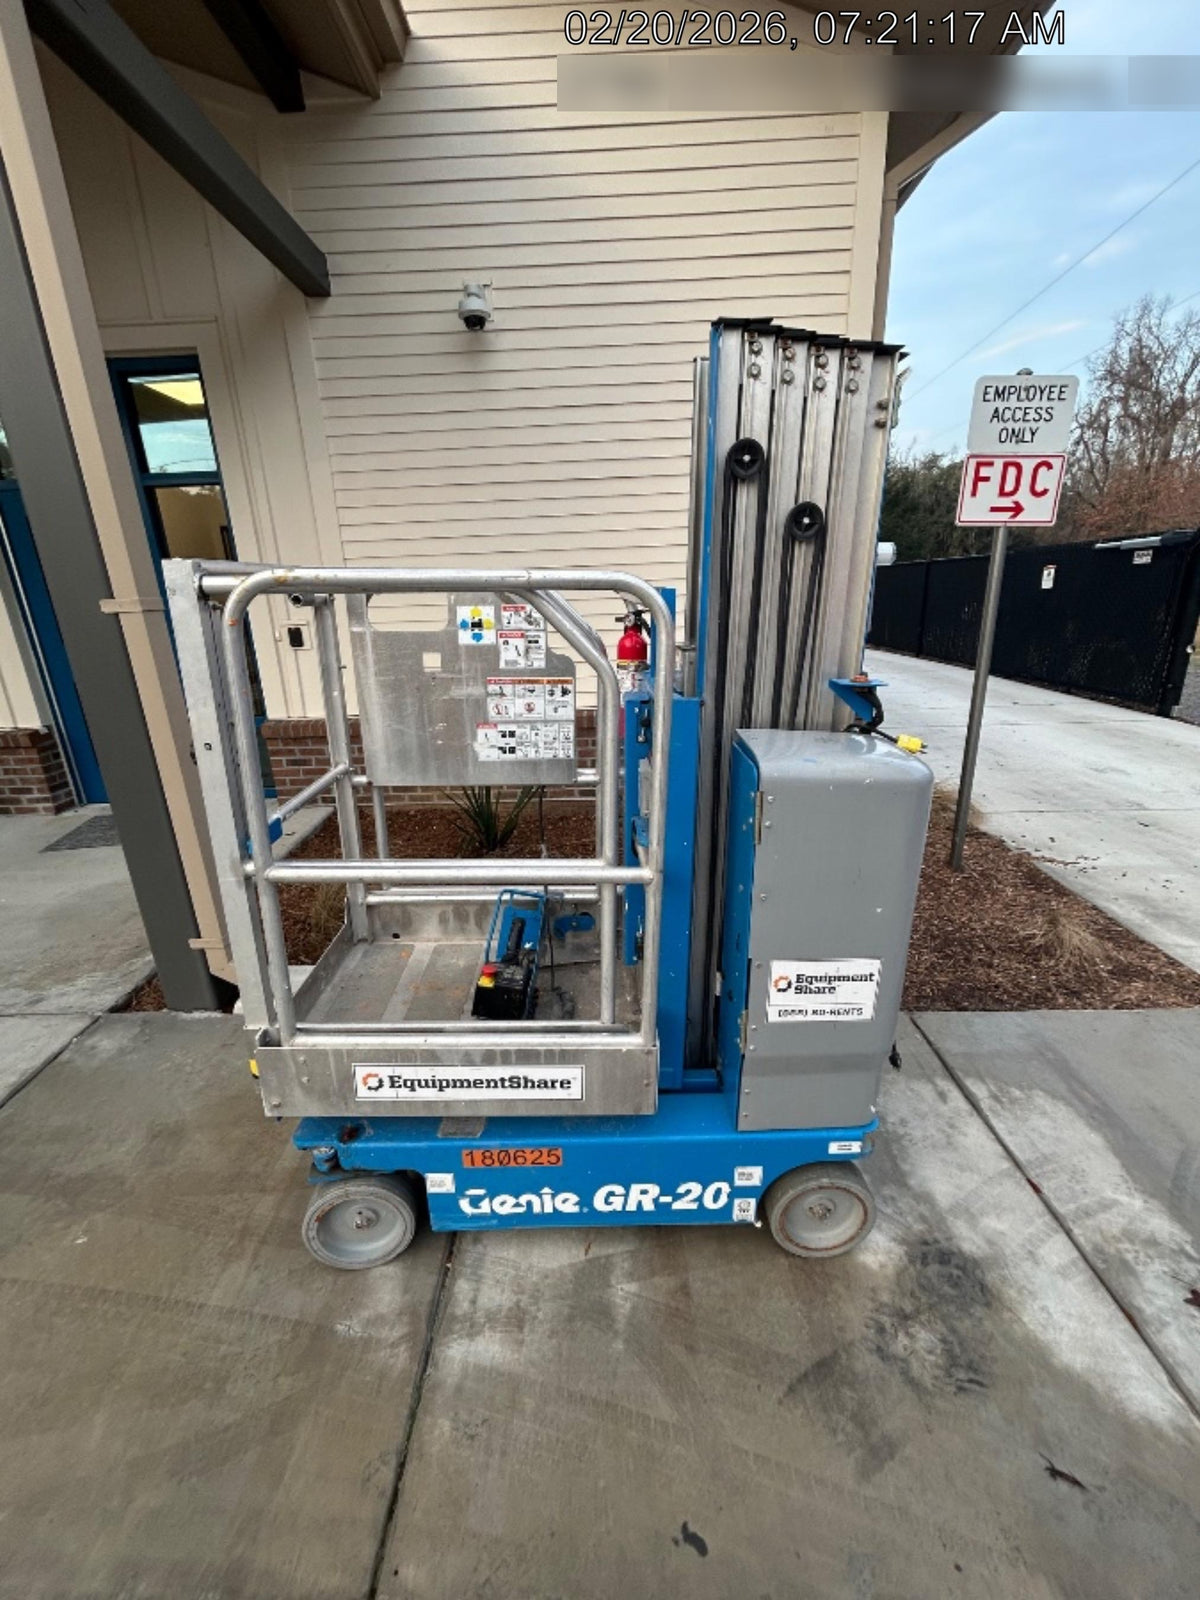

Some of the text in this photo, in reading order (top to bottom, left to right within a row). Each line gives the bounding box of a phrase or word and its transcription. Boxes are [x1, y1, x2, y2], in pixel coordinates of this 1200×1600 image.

[983, 385, 1068, 402] EMPLOYEE
[989, 406, 1054, 423] ACCESS
[998, 427, 1039, 444] ONLY
[970, 460, 1054, 498] FDC
[795, 972, 875, 985] Equipment
[794, 985, 837, 995] Share
[387, 1074, 572, 1092] EquipmentShare
[464, 1149, 562, 1167] 180625
[458, 1181, 731, 1215] Genie GR-20
